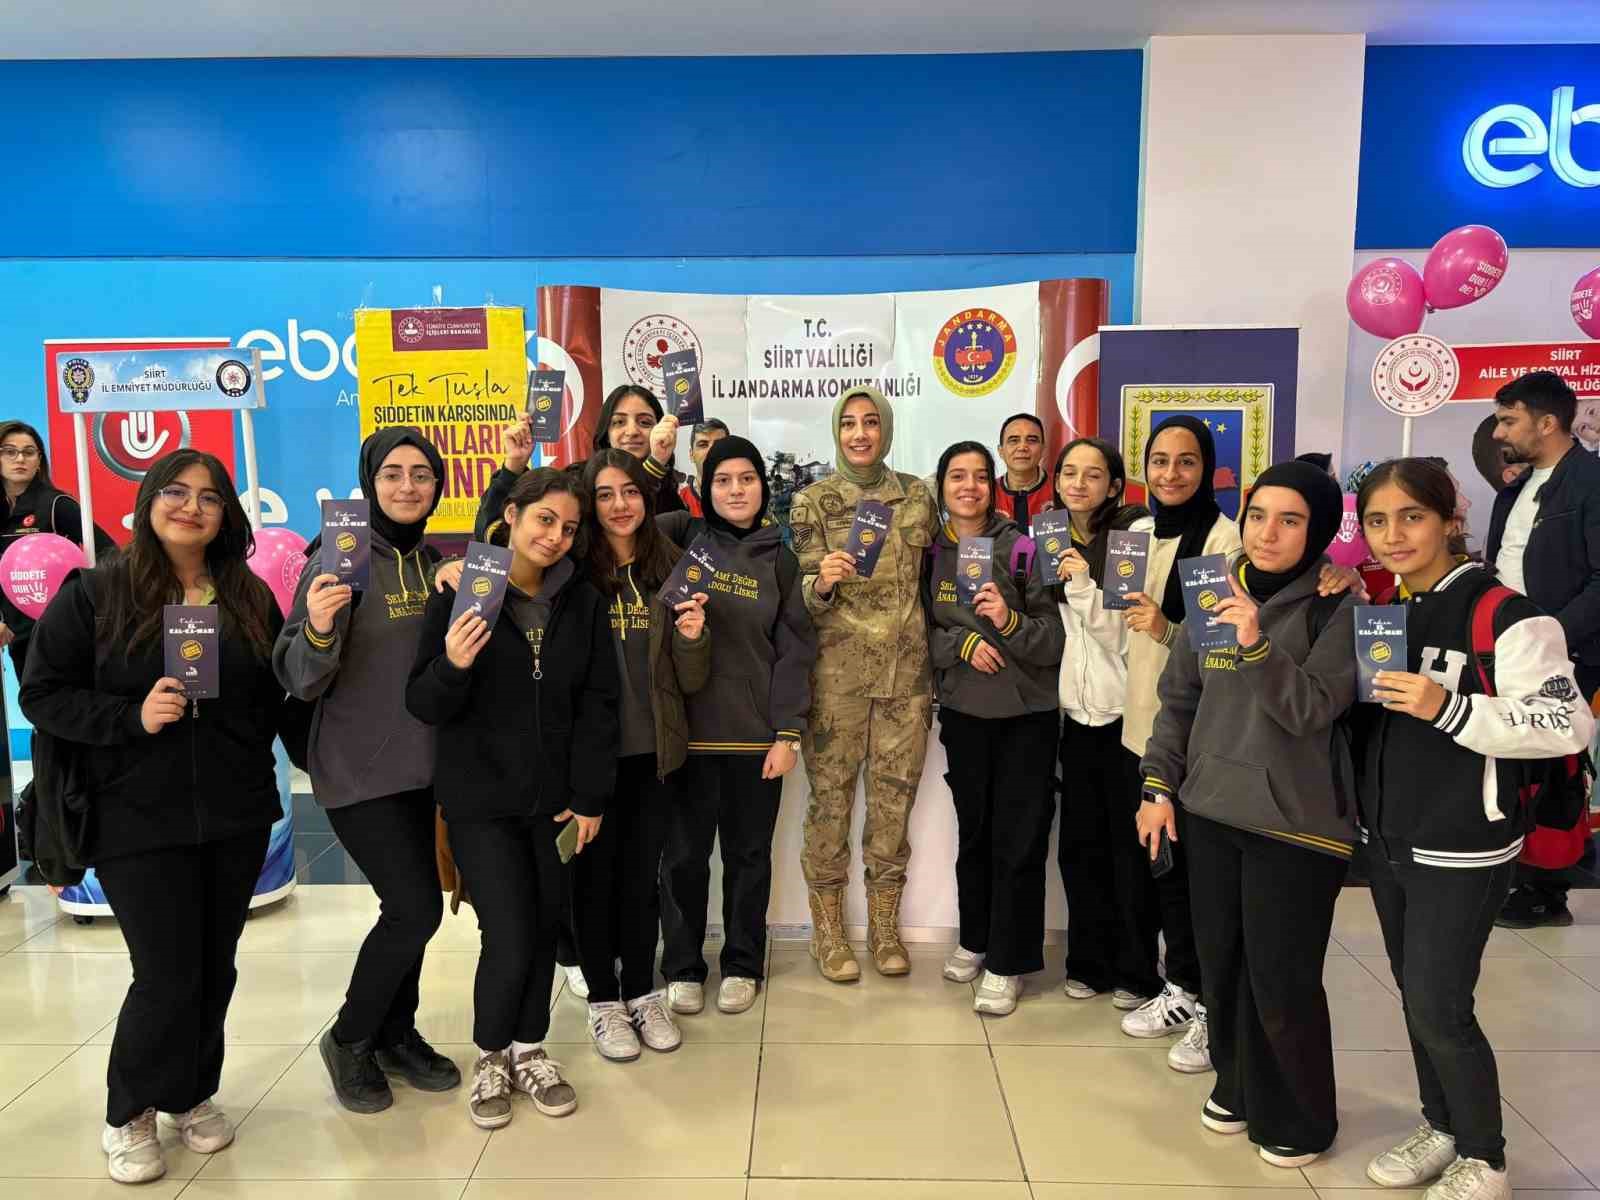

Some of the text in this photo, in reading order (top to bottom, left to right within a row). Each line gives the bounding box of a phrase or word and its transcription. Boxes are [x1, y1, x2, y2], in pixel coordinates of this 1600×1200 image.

[804, 318, 832, 338] T.C.
[764, 342, 873, 369] SİİRT VALİLİĞİ
[1550, 348, 1582, 360] SİİRT
[144, 370, 166, 379] SİİRT
[1479, 366, 1508, 378] AİLE
[1511, 367, 1527, 378] VE
[102, 381, 212, 393] İL EMNİYET MÜDÜRLÜĞÜ
[372, 369, 511, 406] Tek Tuşla
[712, 375, 725, 399] İL
[728, 378, 813, 399] JANDARMA
[374, 404, 517, 424] ŞİDDETİN KARŞISINDA
[1419, 646, 1468, 694] H
